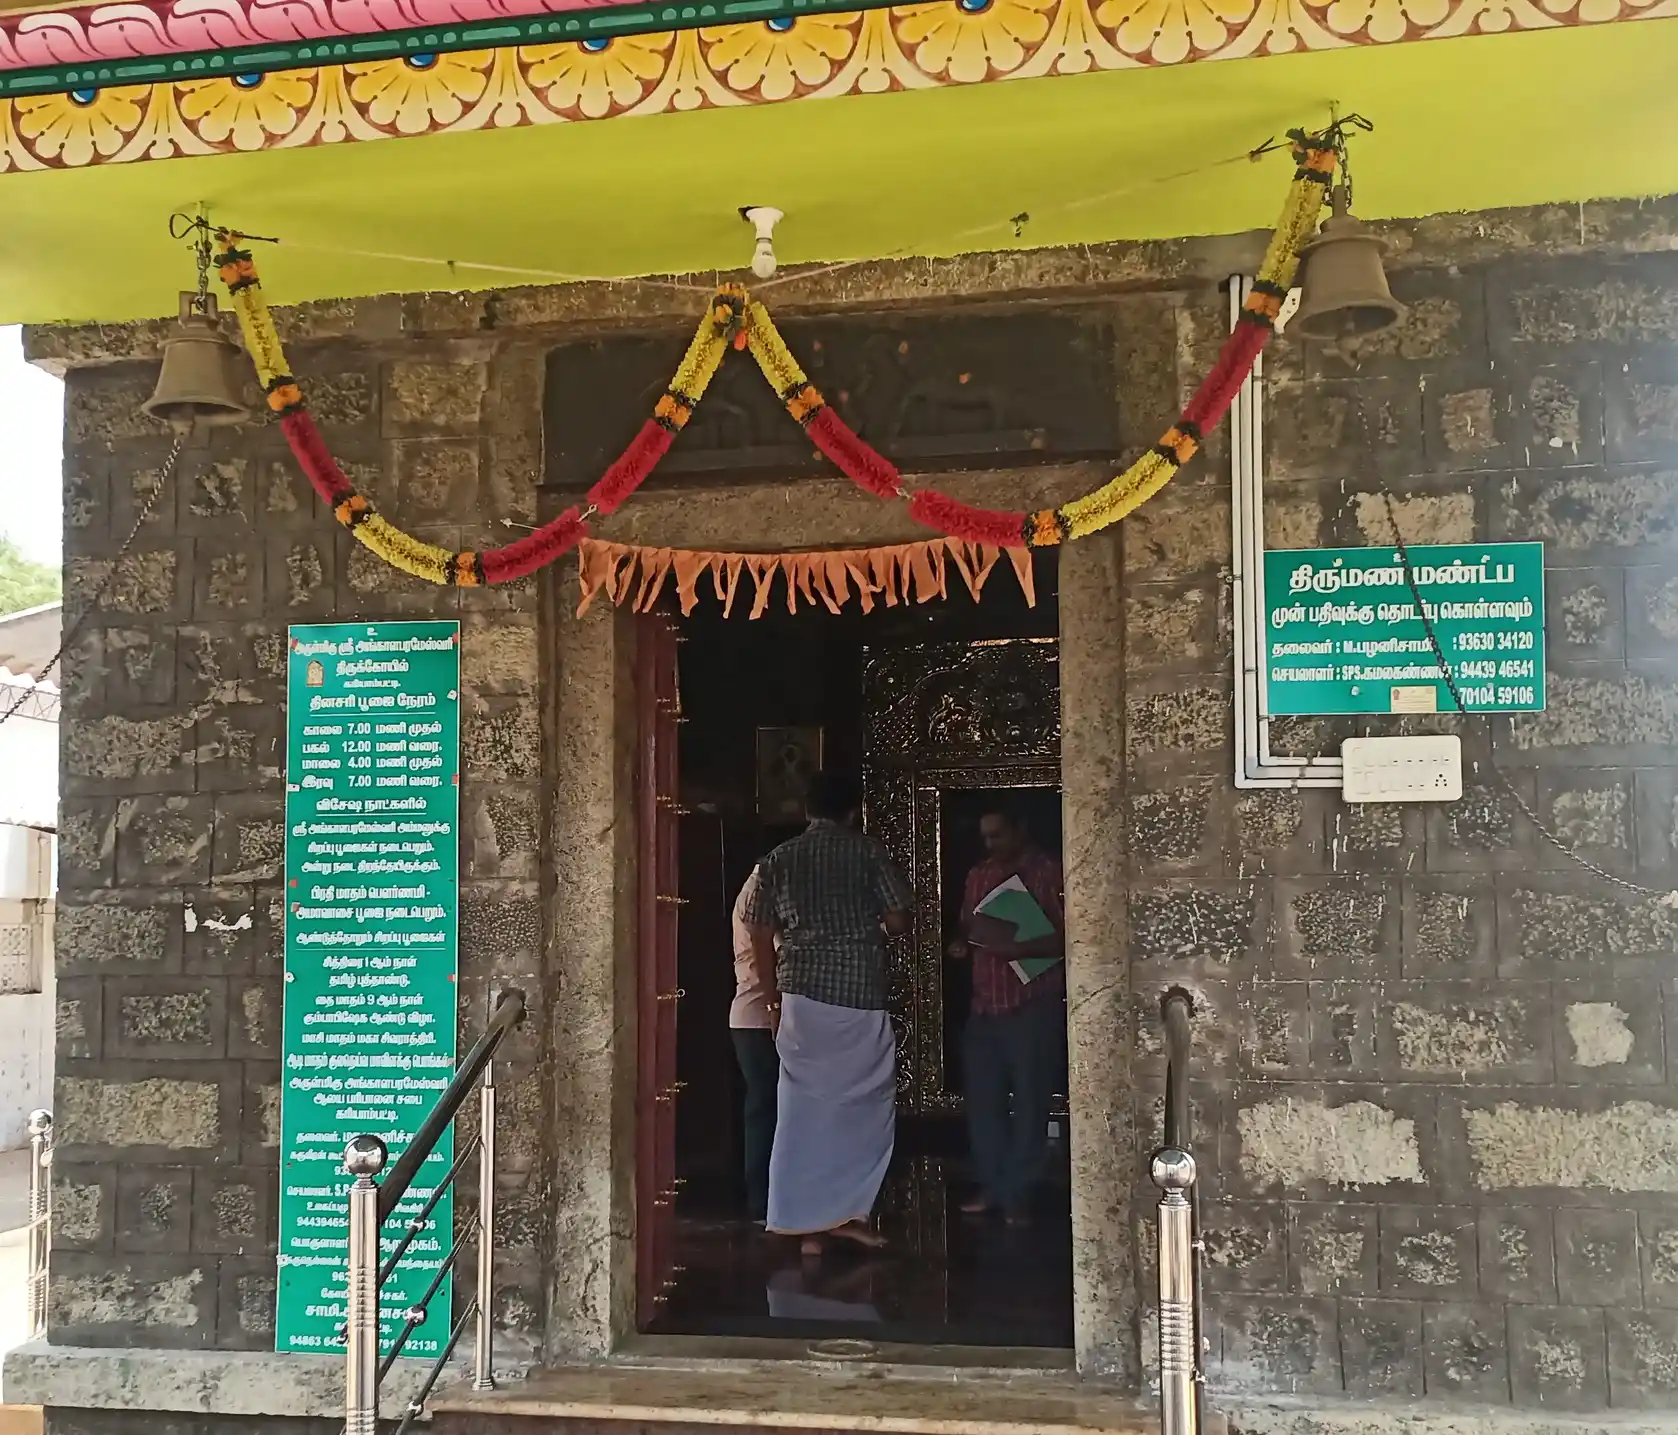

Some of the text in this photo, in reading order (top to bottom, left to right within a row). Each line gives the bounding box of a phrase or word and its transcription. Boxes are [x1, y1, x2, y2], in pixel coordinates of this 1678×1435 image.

[1289, 558, 1514, 595] திருமண மண்டப
[1272, 602, 1306, 628] முன்
[1309, 601, 1374, 626] பதிவுக்கு
[1440, 597, 1532, 621] கொள்ளவும்
[1272, 639, 1333, 658] தலைவர்
[1459, 632, 1494, 650] 93630
[1498, 632, 1533, 649] 34120
[1272, 664, 1334, 681] செயலாளர்
[1461, 661, 1496, 678] 94439
[1499, 660, 1533, 677] 46541
[310, 693, 435, 711] தினசரி பூஜை நேரம்
[1459, 686, 1533, 705] 70104 59106
[303, 721, 441, 736] காலை 7.00 மணி முதல்
[303, 742, 329, 753] பகல்
[342, 741, 371, 752] 12.00
[376, 740, 406, 751] மணி
[302, 755, 442, 770] மாலை 4.00 மணி முதல்
[302, 775, 333, 789] இரவு
[349, 775, 371, 786] 7.00
[376, 775, 407, 786] மணி
[365, 797, 426, 812] நாட்களில்
[302, 861, 331, 874] அன்று
[333, 863, 356, 874] நடை
[336, 885, 367, 901] மாதம்
[356, 908, 384, 923] பூஜை
[316, 996, 334, 1007] தை
[336, 994, 365, 1007] மாதம்
[367, 995, 374, 1005] 9
[302, 1032, 324, 1043] மாசி
[326, 1032, 355, 1045] மாதம்
[357, 1035, 379, 1043] மகா
